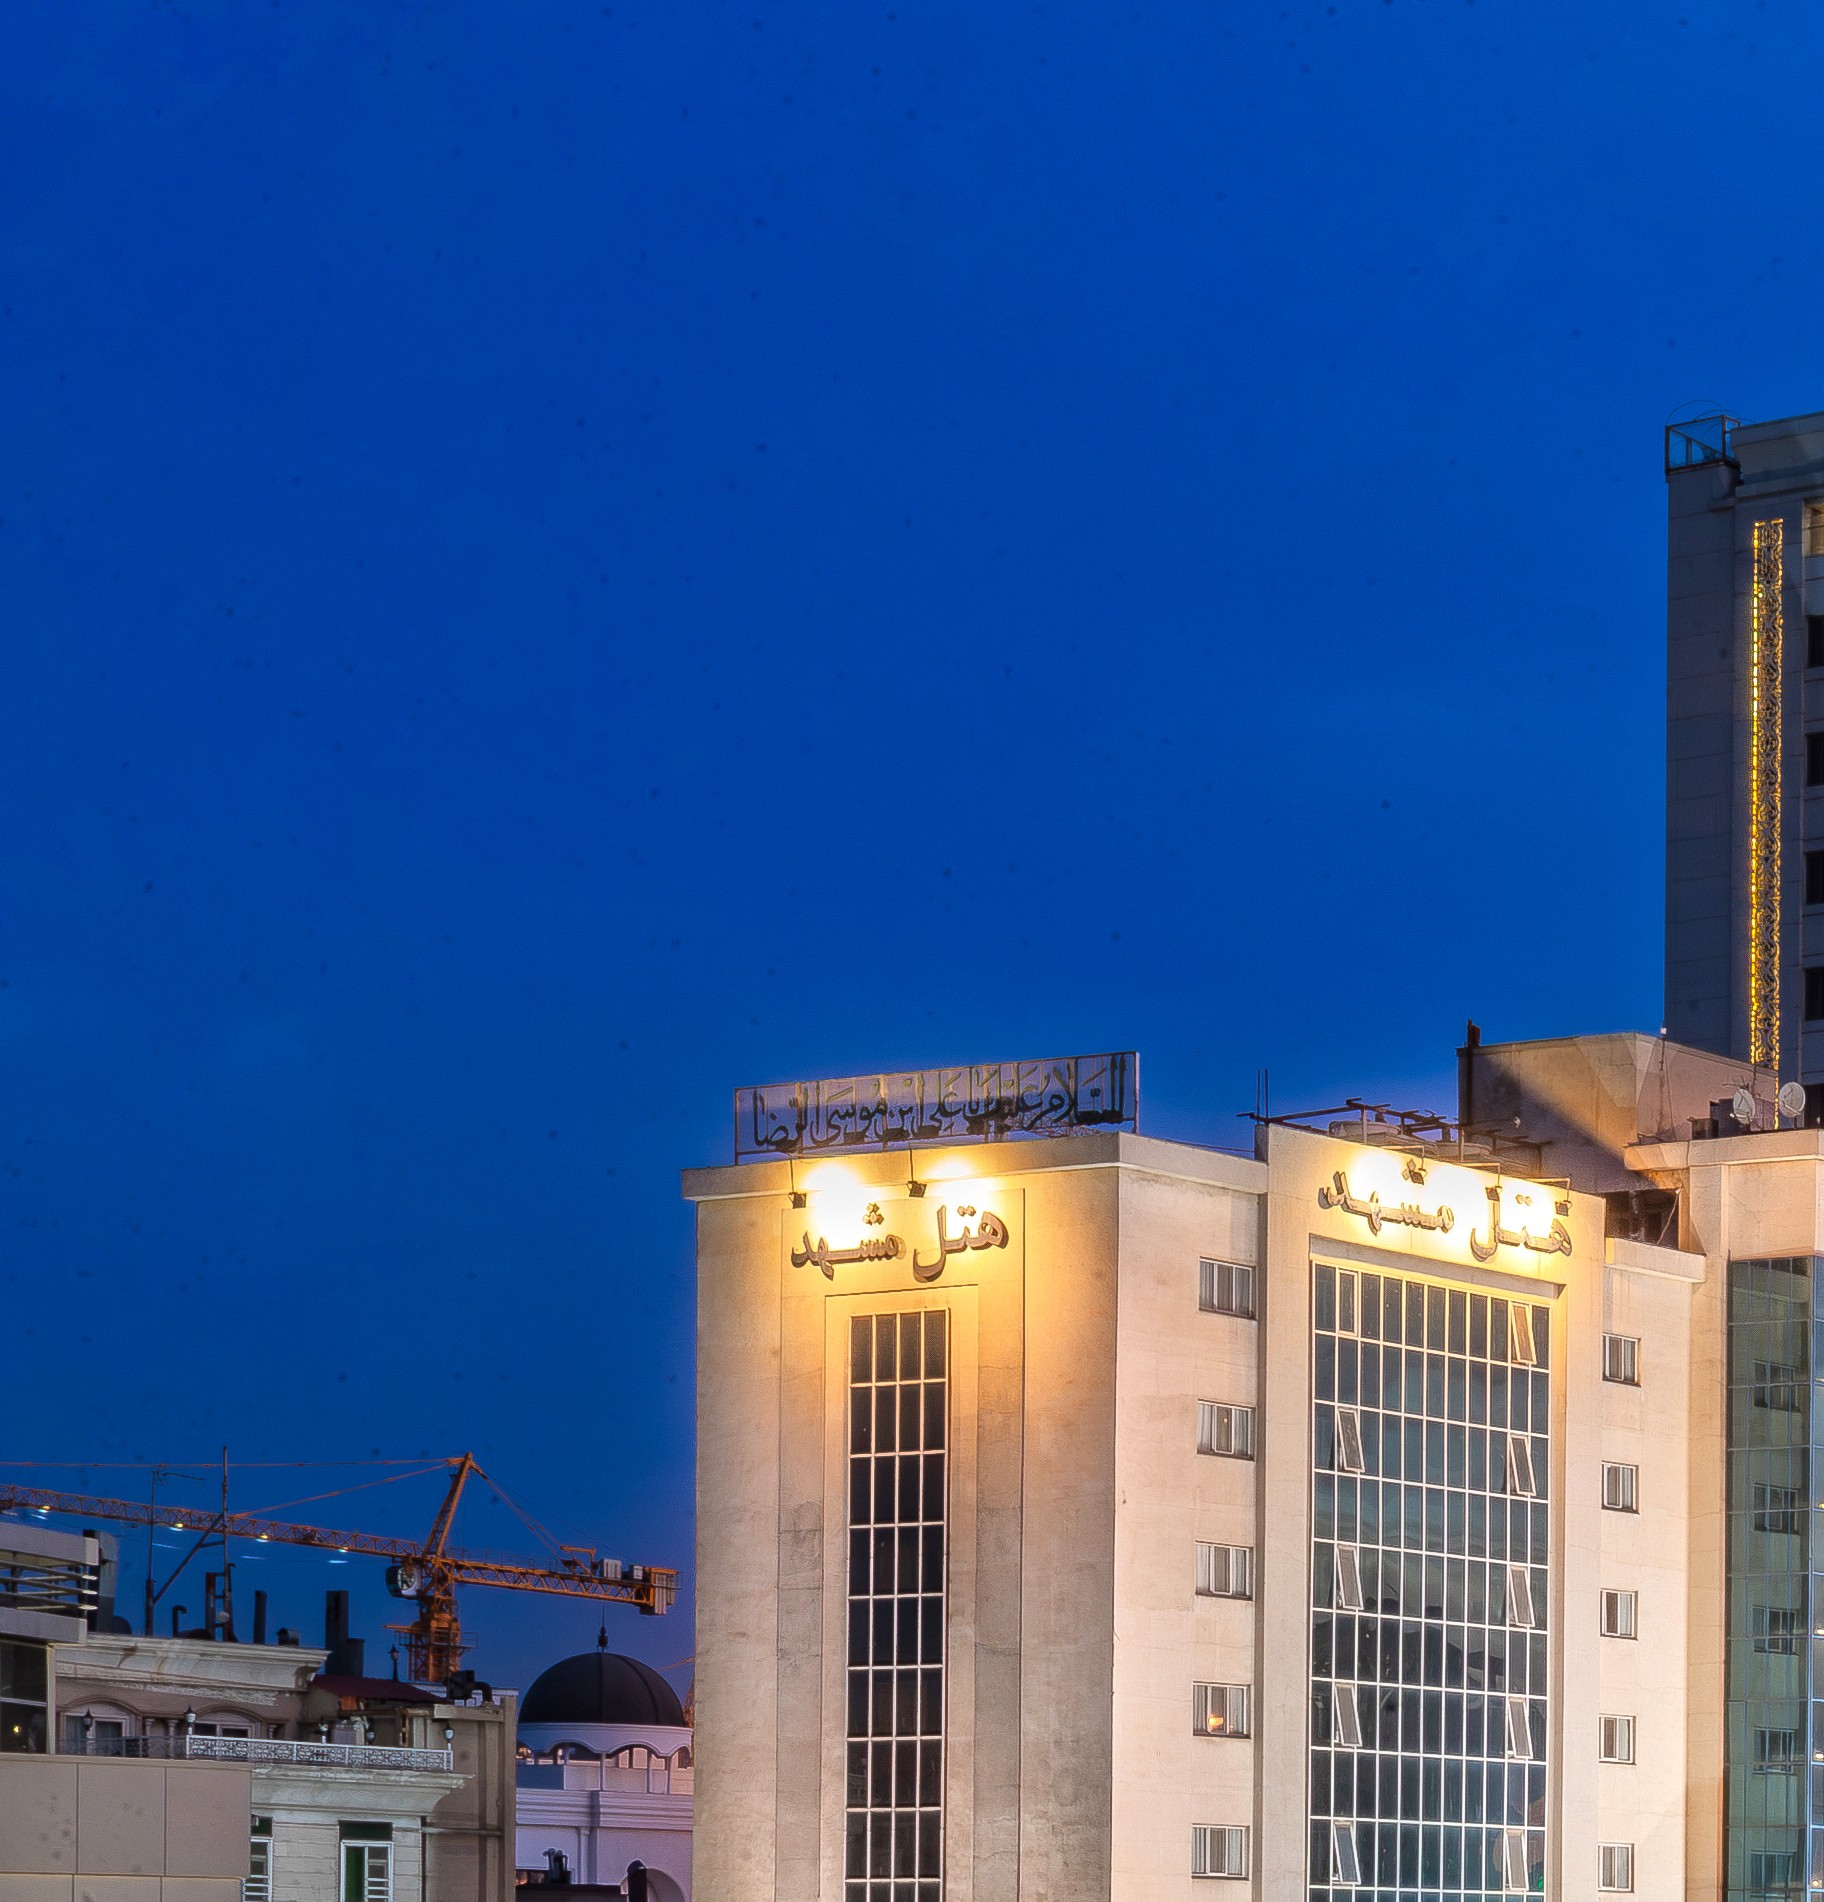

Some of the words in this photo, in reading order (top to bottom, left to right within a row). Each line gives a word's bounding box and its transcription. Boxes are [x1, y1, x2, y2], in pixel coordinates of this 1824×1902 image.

[1318, 1159, 1455, 1235] مشهد
[1470, 1187, 1572, 1262] هتل
[790, 1202, 906, 1281] مشهد
[911, 1204, 1010, 1284] هتل
